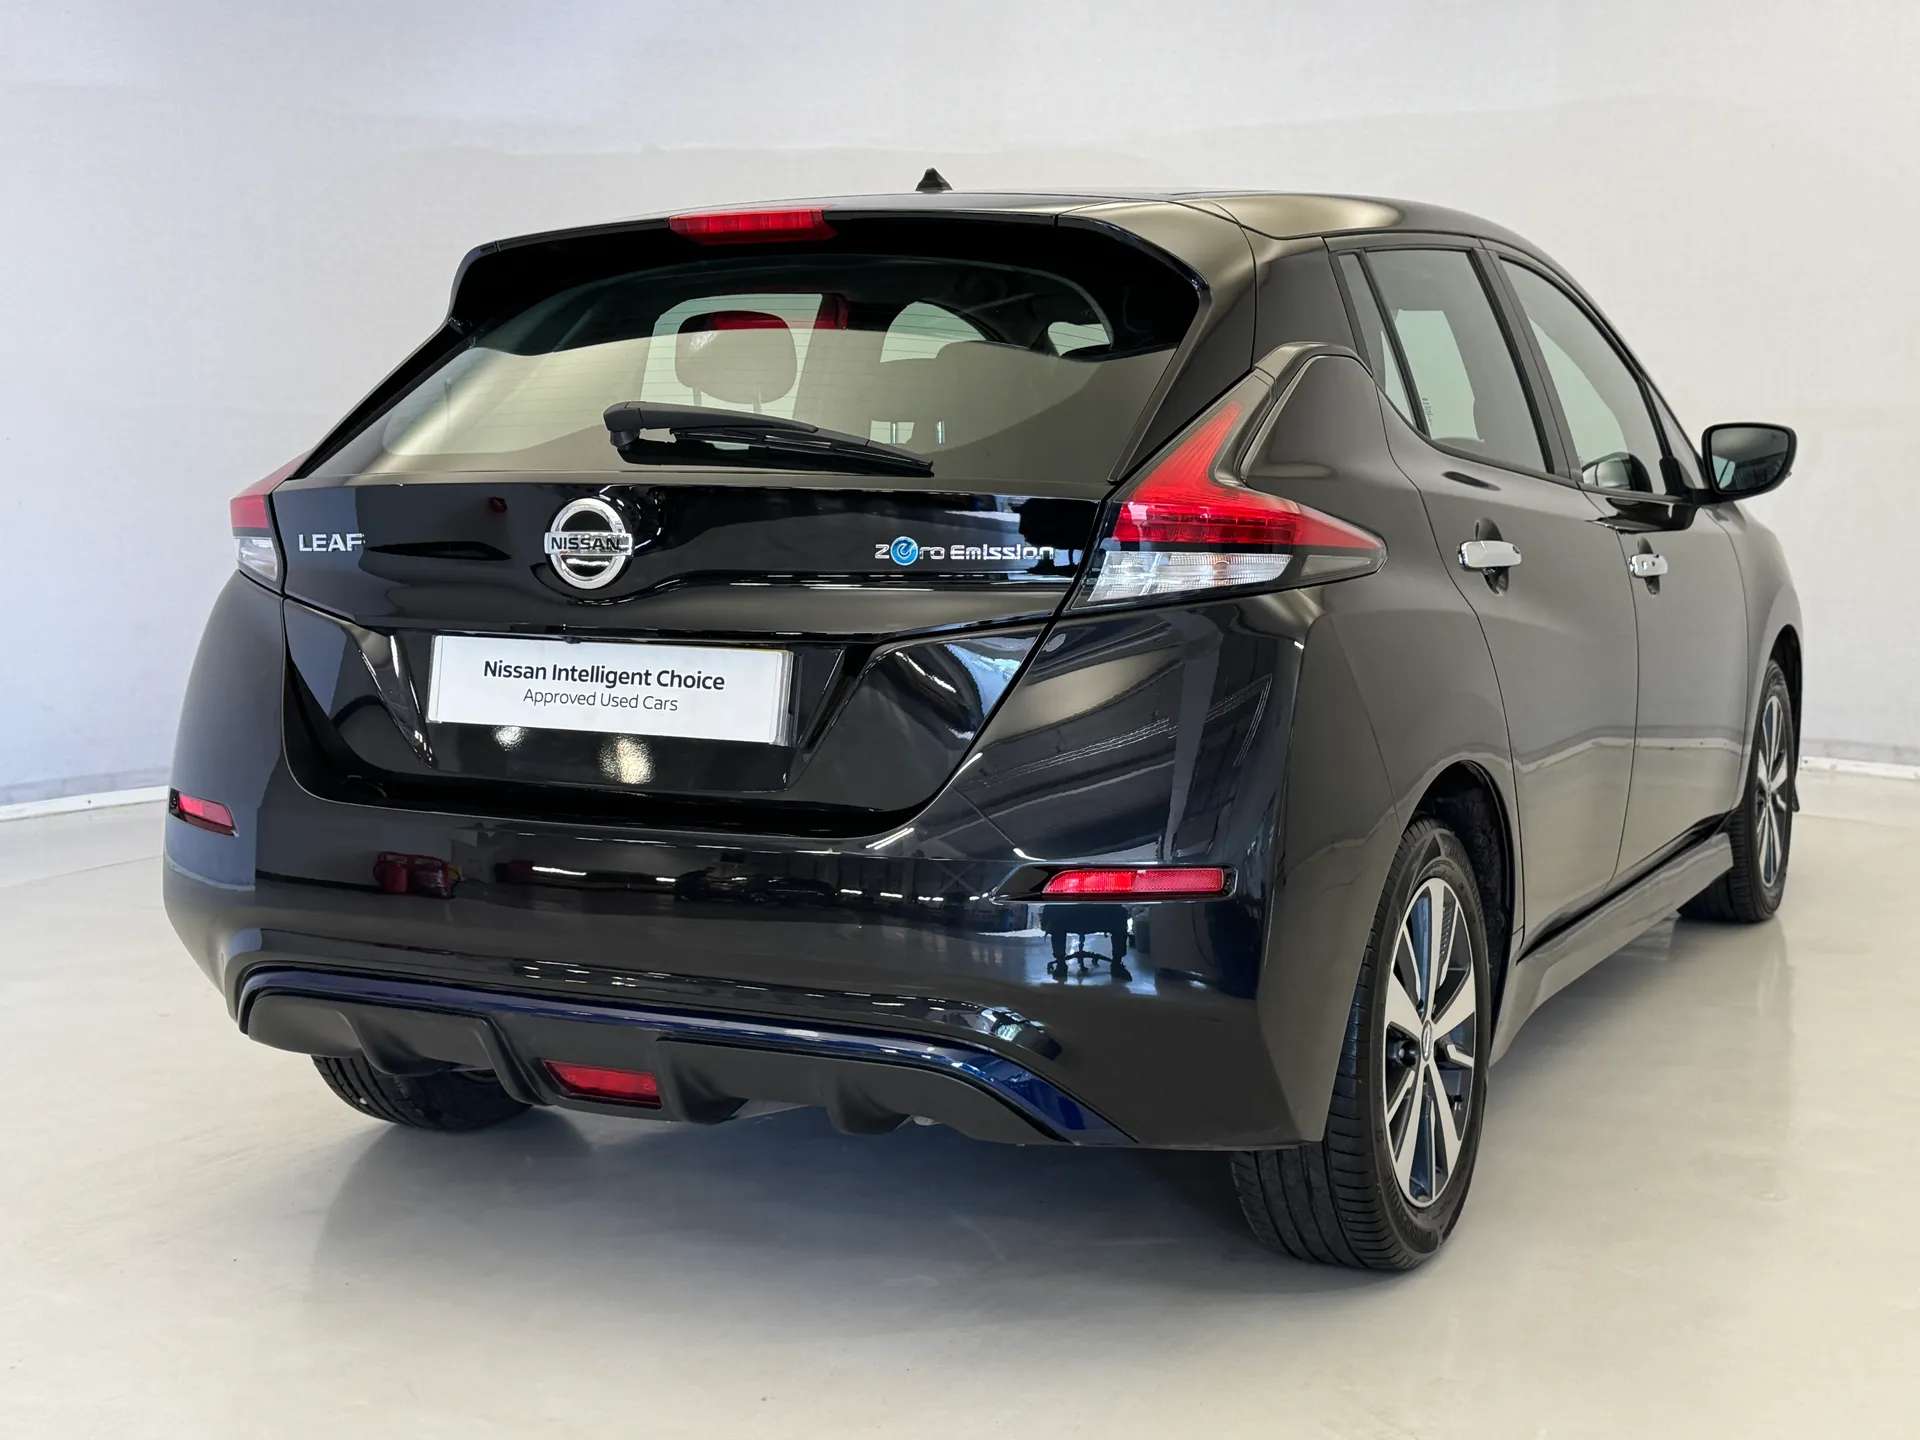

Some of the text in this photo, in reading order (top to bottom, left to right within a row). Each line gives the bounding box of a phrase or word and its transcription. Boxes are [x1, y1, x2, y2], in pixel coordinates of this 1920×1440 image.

[298, 533, 365, 552] LEAF
[550, 535, 621, 552] NISSAN
[950, 544, 1054, 560] Emission
[483, 660, 726, 690] Nissan Intelligent Choice
[523, 688, 679, 711] Approved Used Cars
